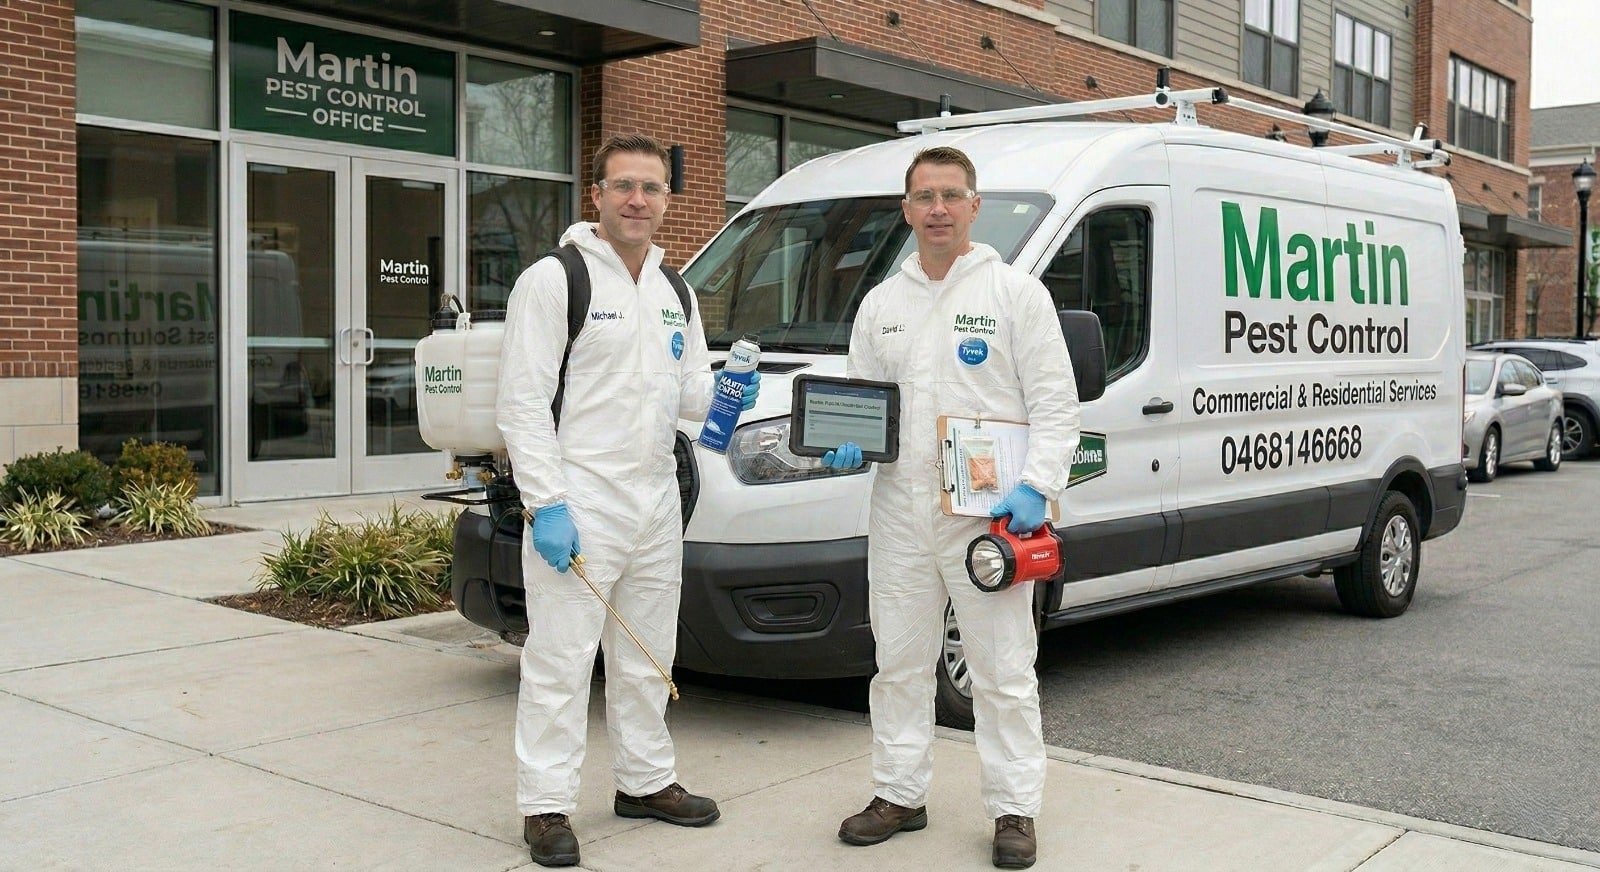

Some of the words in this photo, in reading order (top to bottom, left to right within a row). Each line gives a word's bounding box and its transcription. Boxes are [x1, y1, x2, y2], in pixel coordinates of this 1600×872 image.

[276, 36, 418, 95] Martin
[266, 77, 322, 101] PEST
[326, 87, 426, 118] CONTROL
[312, 107, 385, 133] OFFICE
[1221, 200, 1409, 306] Martin
[380, 259, 429, 275] Martin
[380, 275, 399, 283] Pest
[400, 275, 429, 285] Control
[591, 310, 618, 321] Michael
[618, 311, 625, 320] J.
[955, 314, 996, 327] Martin
[953, 325, 969, 333] Pest
[969, 326, 996, 335] Control
[1225, 310, 1298, 354] Pest
[1307, 312, 1409, 354] Control
[962, 347, 984, 356] Tyvek
[425, 365, 462, 382] Martin
[425, 385, 438, 394] Pest
[438, 384, 462, 394] Control
[1192, 384, 1293, 415] Commercial
[1297, 383, 1308, 408] &
[1312, 380, 1386, 407] Residential
[1389, 379, 1437, 403] Services
[1221, 424, 1362, 475] 0468146668
